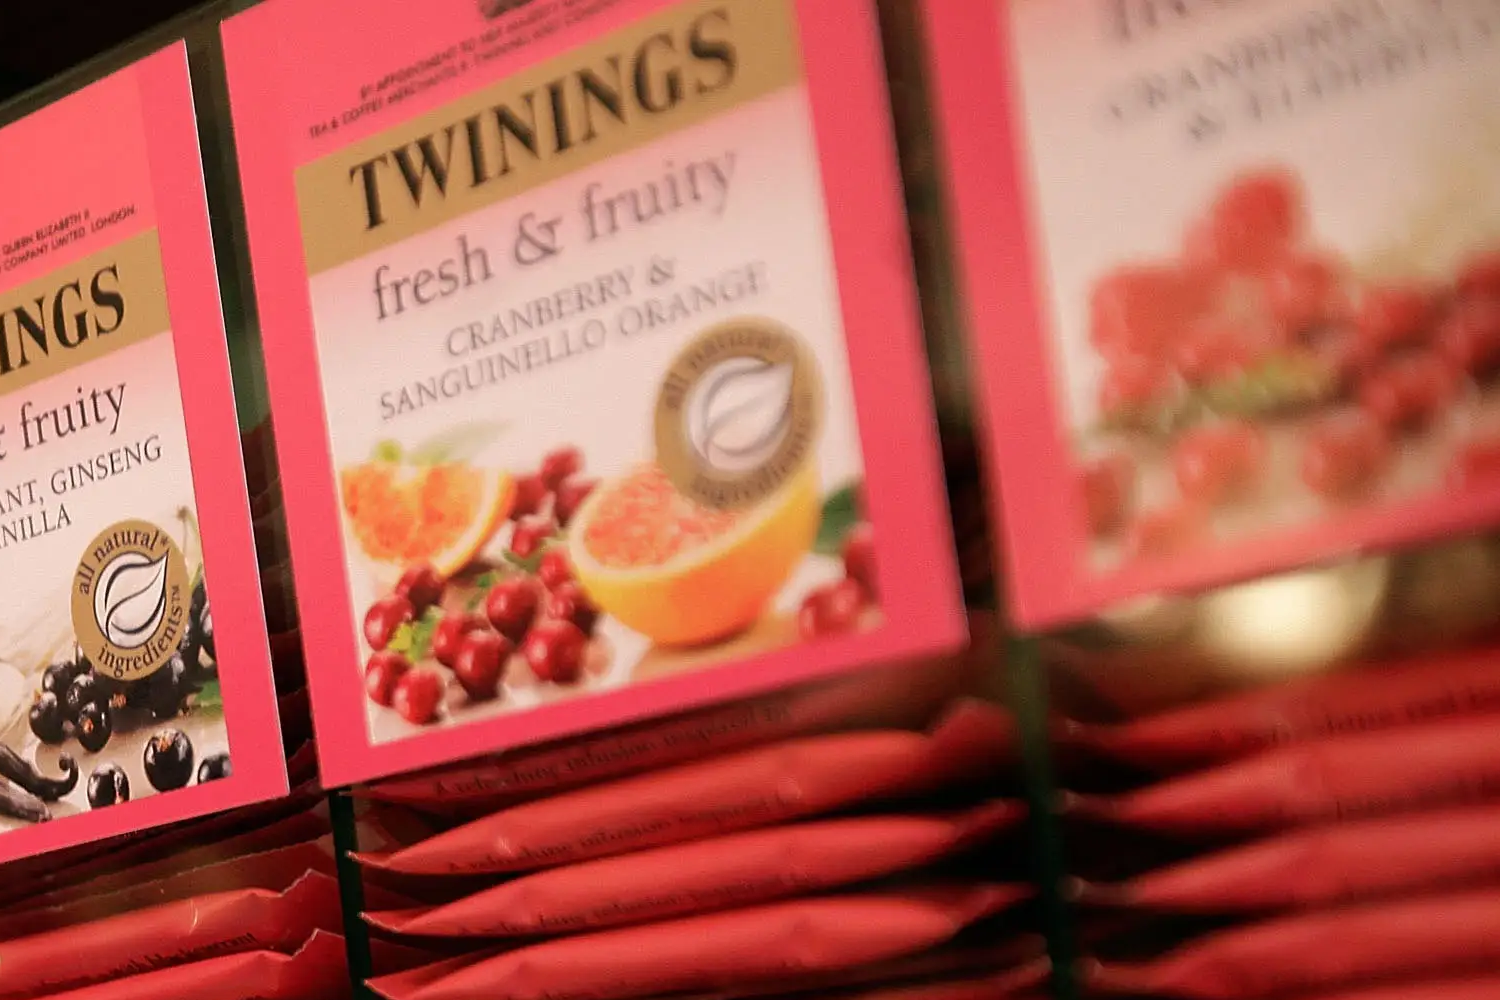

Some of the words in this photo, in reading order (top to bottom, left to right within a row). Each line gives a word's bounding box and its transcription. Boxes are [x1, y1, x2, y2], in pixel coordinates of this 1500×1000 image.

[349, 8, 737, 232] TWININGS
[4, 244, 49, 271] COMPANY
[51, 226, 86, 250] LIMITED
[91, 204, 135, 233] LONDON
[36, 213, 82, 241] ELIZABETH
[373, 235, 492, 321] fresh
[514, 213, 564, 269] &
[581, 152, 737, 246] fruity
[446, 267, 635, 357] CRANBERRY
[648, 255, 677, 288] &
[379, 318, 607, 422] SANGUINELLO
[620, 261, 768, 337] ORANGE
[20, 382, 127, 451] fruity
[50, 434, 162, 495] GINSENG
[78, 560, 96, 596] all
